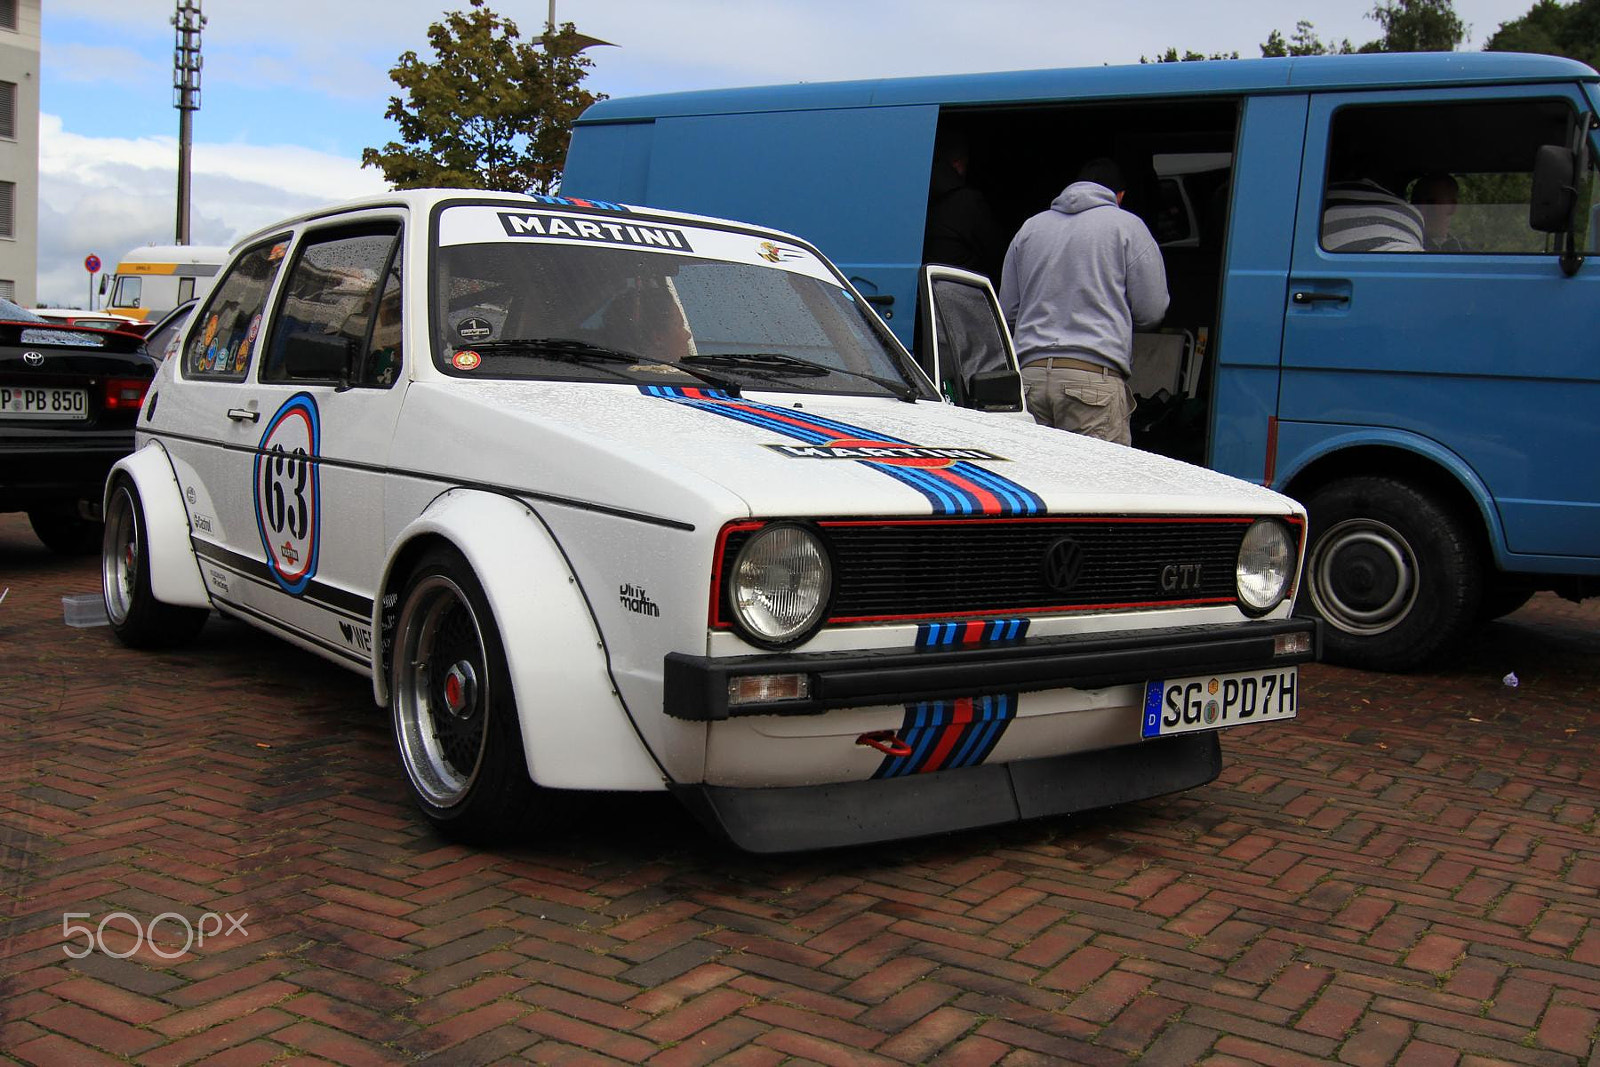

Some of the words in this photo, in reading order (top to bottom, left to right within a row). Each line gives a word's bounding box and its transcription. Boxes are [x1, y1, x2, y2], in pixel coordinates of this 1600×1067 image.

[508, 215, 683, 248] MARTINI
[25, 390, 47, 411] PB
[52, 391, 83, 411] 850
[781, 446, 992, 459] MARTINI
[264, 443, 308, 541] 63
[1160, 563, 1202, 591] GTI
[1148, 713, 1156, 726] D
[1163, 682, 1203, 728] SG
